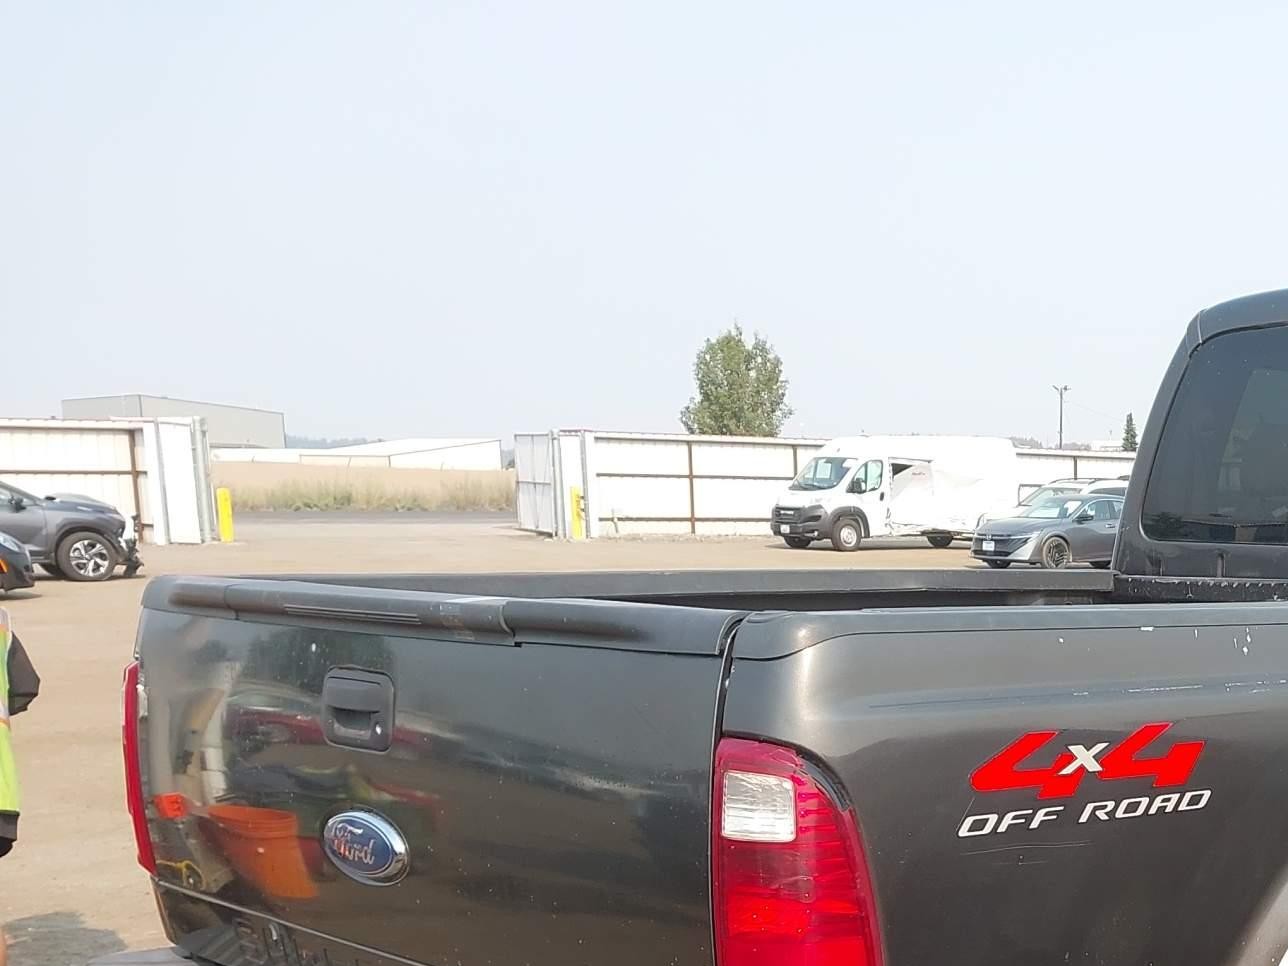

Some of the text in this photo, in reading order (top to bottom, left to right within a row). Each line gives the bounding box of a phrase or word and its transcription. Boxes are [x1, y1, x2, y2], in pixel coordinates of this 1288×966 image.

[969, 722, 1204, 799] 4x4
[957, 790, 1212, 837] OFF ROAD
